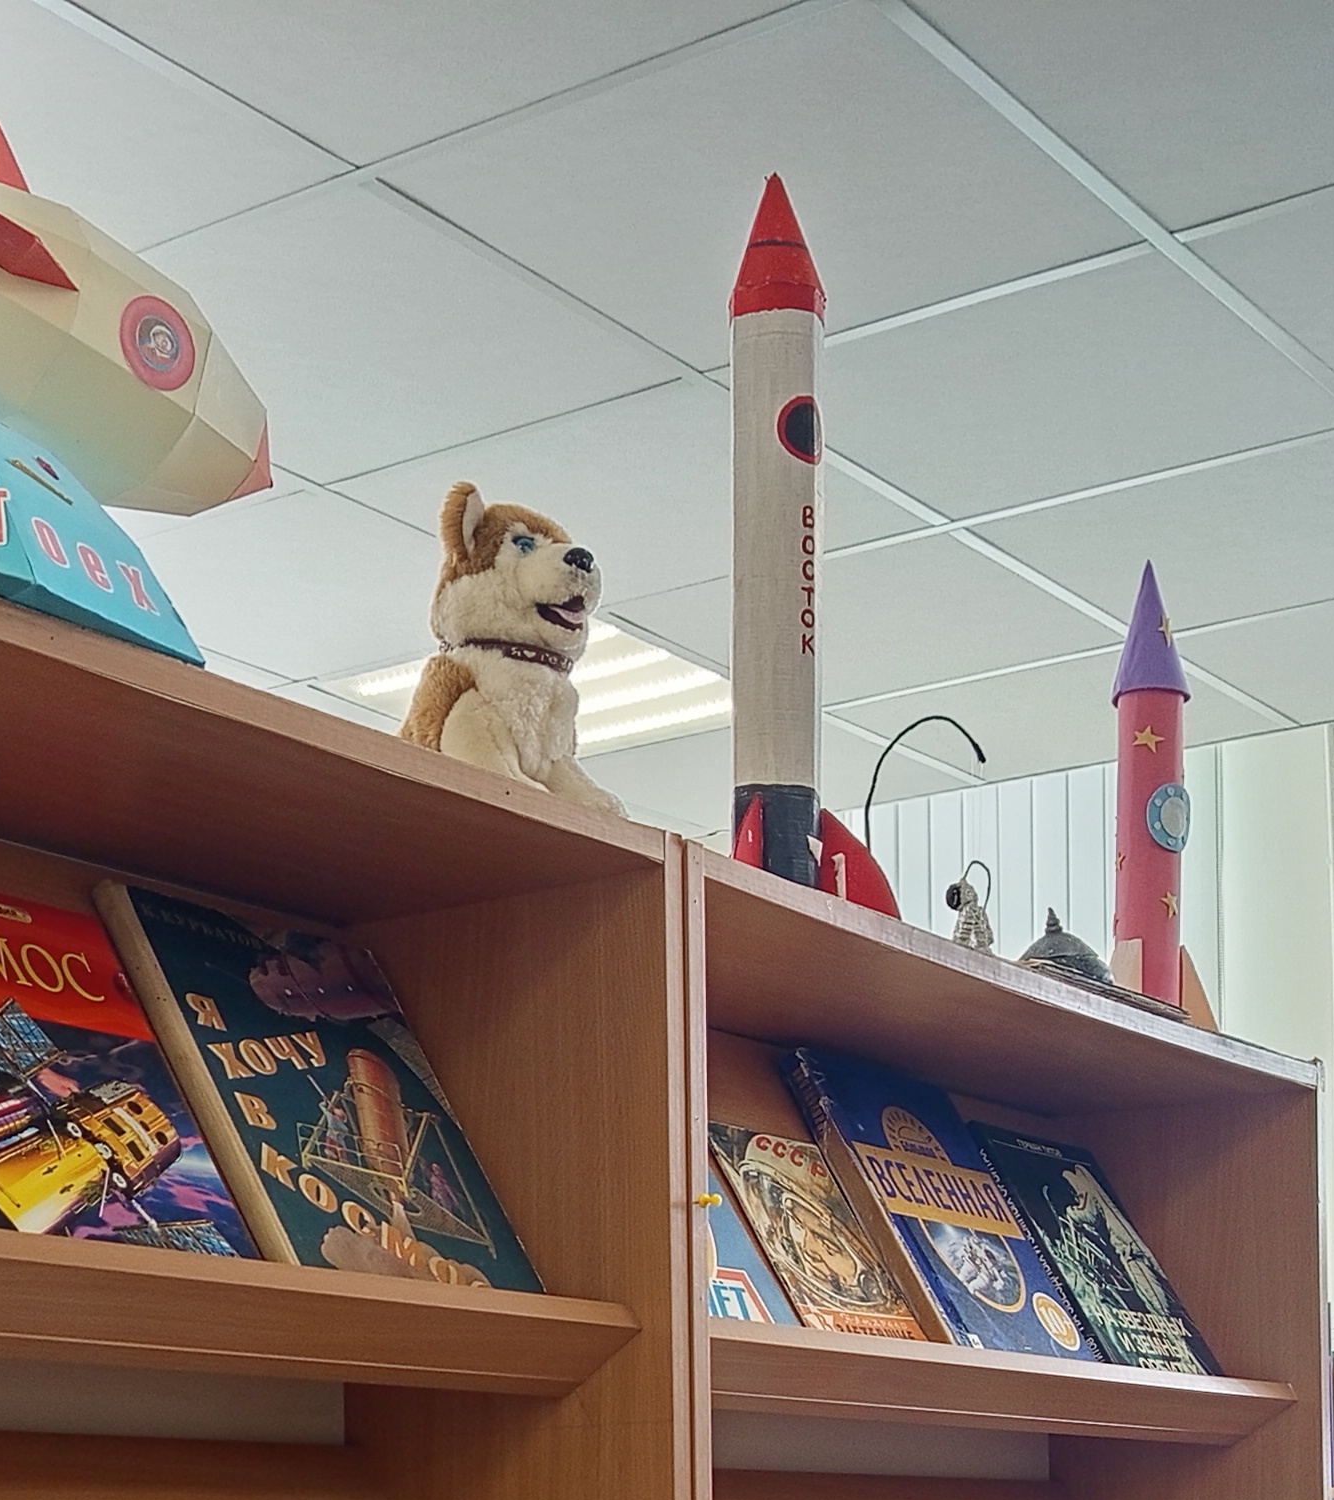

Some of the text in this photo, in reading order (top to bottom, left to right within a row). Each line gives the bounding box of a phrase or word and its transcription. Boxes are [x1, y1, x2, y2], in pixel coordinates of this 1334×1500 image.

[186, 992, 228, 1032] Я
[207, 1030, 327, 1080] ХОЧУ
[234, 1091, 277, 1130] В
[755, 1134, 829, 1179] СССР
[868, 1154, 1012, 1224] ВСЕЛЕННАЯ
[261, 1142, 492, 1288] КОСМО
[1096, 1309, 1116, 1327] НА
